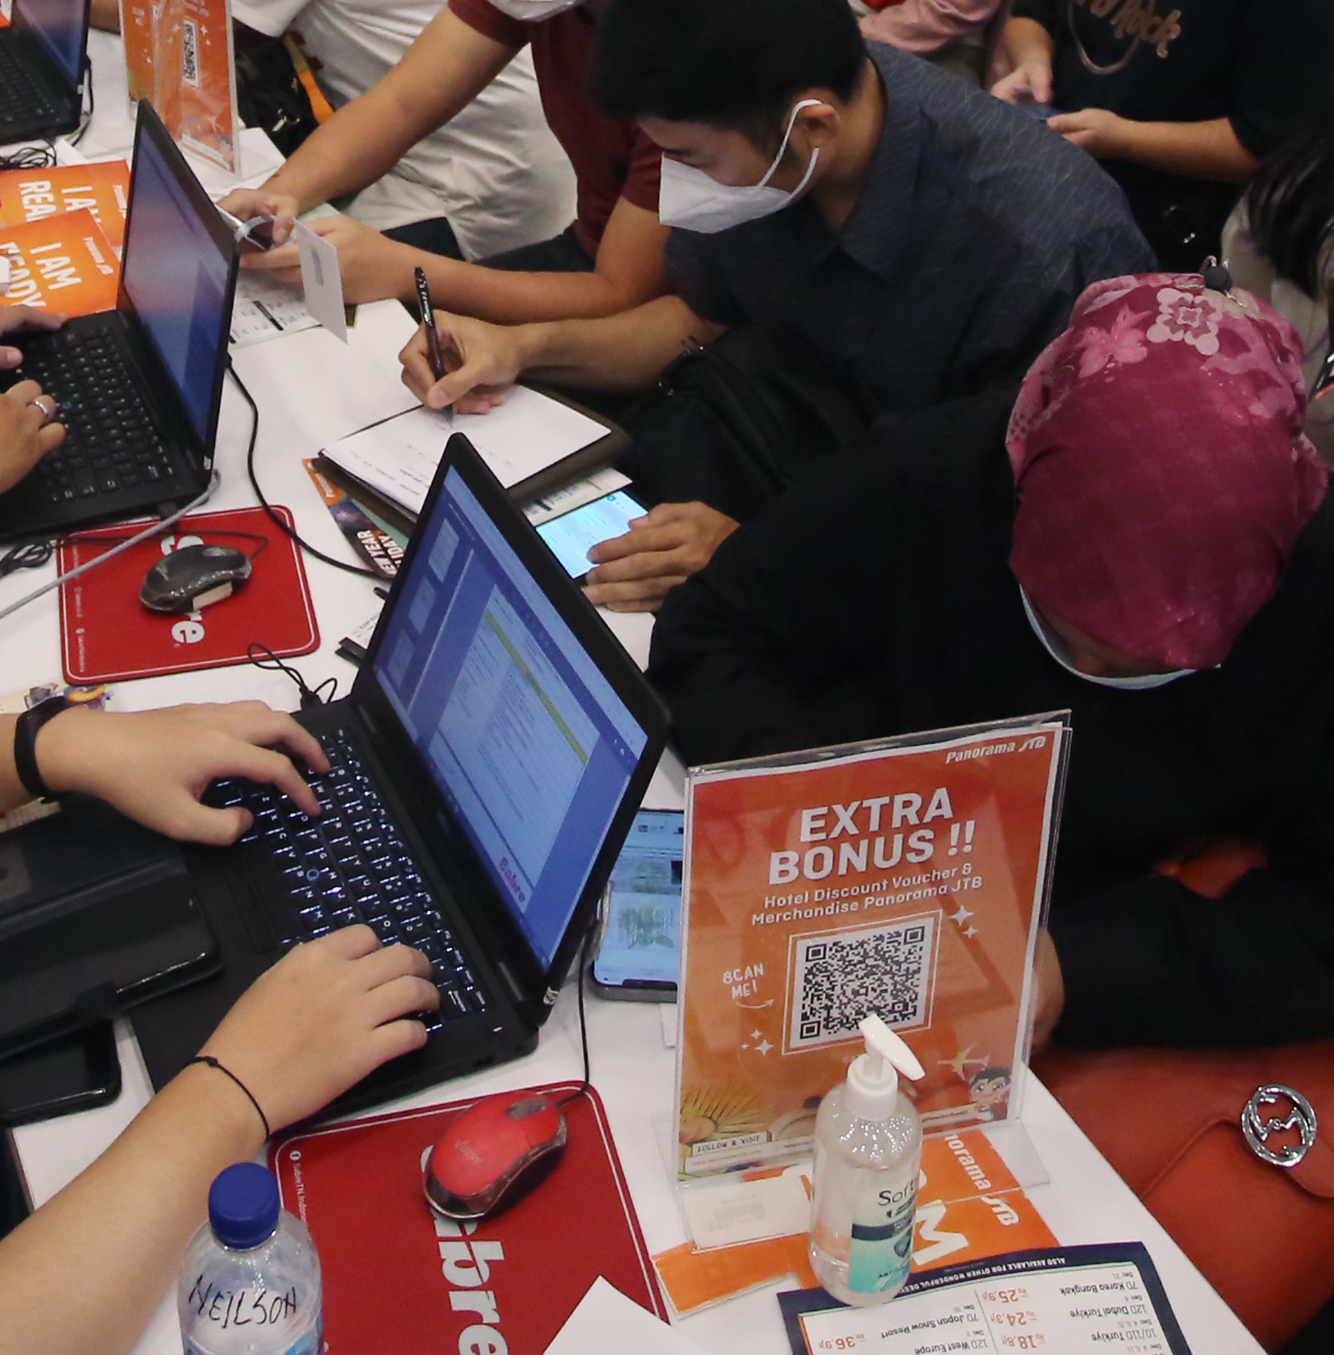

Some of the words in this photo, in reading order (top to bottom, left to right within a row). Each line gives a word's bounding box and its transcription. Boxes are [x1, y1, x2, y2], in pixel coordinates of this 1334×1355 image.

[35, 256, 82, 290] AM
[357, 530, 384, 558] YEAR
[945, 741, 1015, 764] Panorama
[1018, 736, 1047, 753] JTB
[800, 787, 954, 842] EXTRA
[769, 829, 935, 885] BONUS
[947, 820, 976, 856] !!
[764, 892, 809, 909] Hotel
[814, 878, 889, 902] Discount
[892, 866, 957, 889] Voucher
[961, 863, 973, 875] &
[752, 900, 859, 926] Merchandise
[864, 885, 948, 910] Panorama
[951, 876, 983, 893] JTB
[981, 1195, 1020, 1226] JTB
[1007, 1259, 1046, 1271] AVAILABLE
[1047, 1257, 1066, 1266] ALSO
[965, 1267, 991, 1279] OTHER
[991, 1264, 1006, 1274] FOR
[919, 1271, 965, 1289] WONDERFUL
[1059, 1284, 1099, 1296] Bangkok
[1099, 1282, 1125, 1291] Korea
[1070, 1307, 1104, 1318] Turkiye
[1104, 1306, 1129, 1316] Dubai
[1130, 1305, 1147, 1314] 12D
[911, 1319, 937, 1332] Snow
[937, 1314, 967, 1325] Japan
[880, 1324, 910, 1339] Resort
[1091, 1331, 1125, 1343] Turkiye
[1126, 1328, 1156, 1340] 10/11D
[914, 1342, 948, 1355] Europe
[948, 1339, 971, 1352] West
[971, 1338, 988, 1350] 12D
